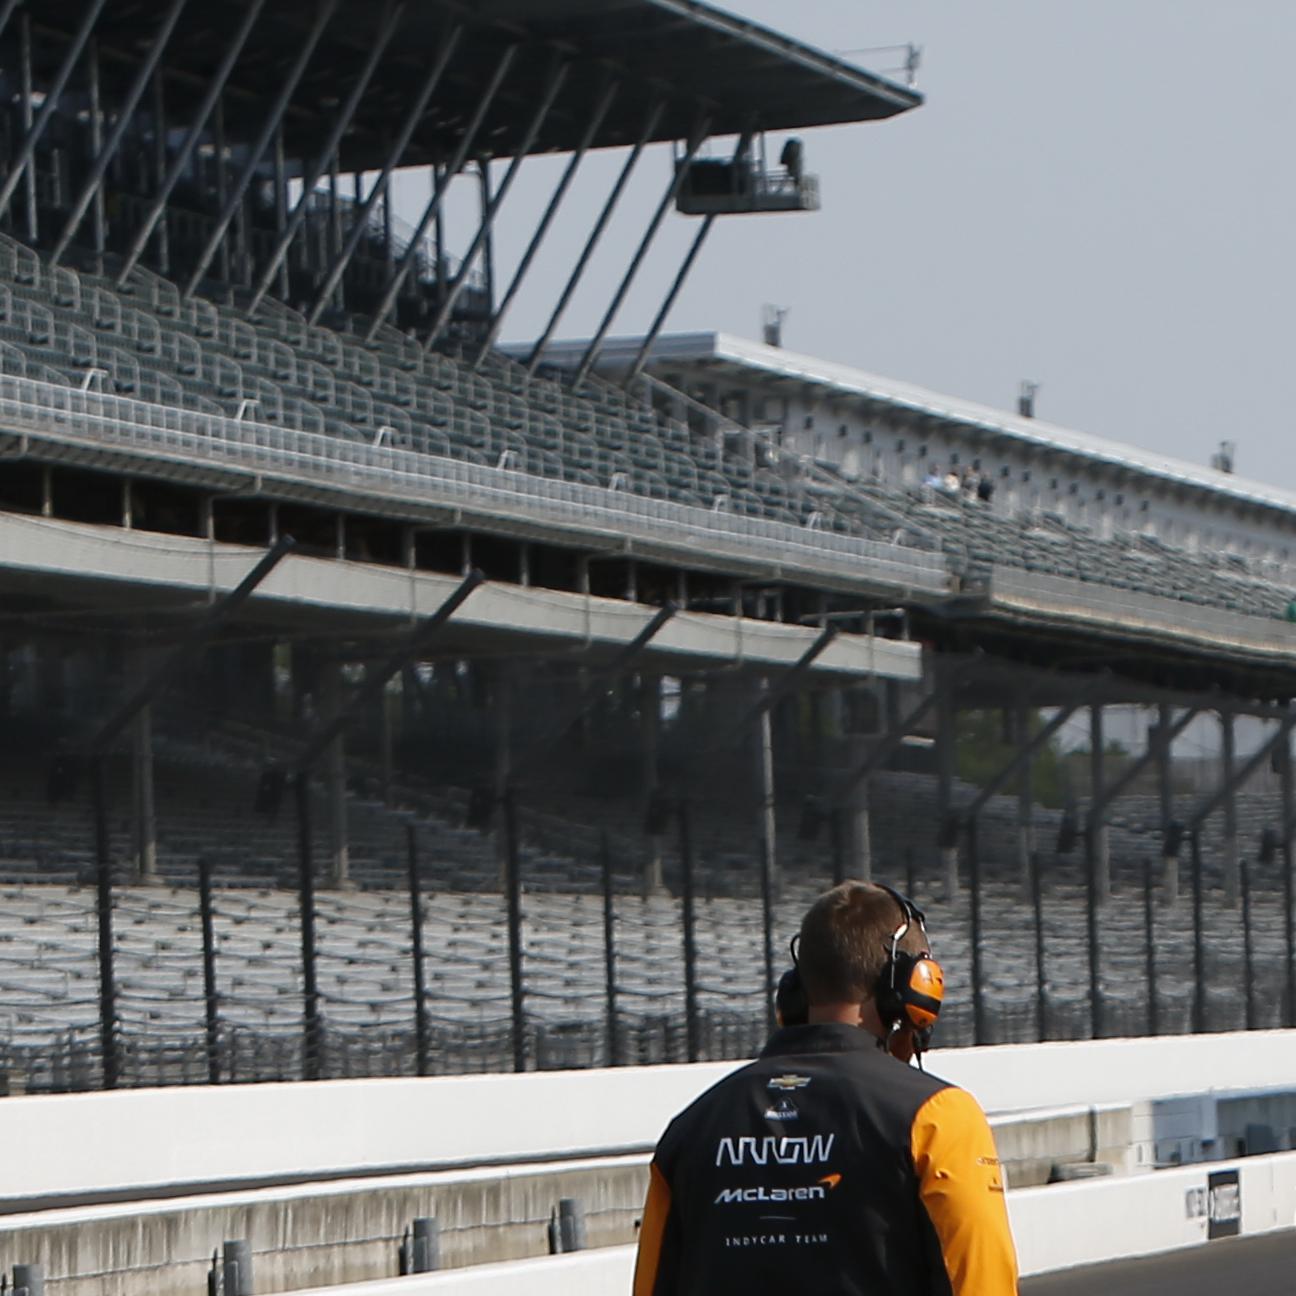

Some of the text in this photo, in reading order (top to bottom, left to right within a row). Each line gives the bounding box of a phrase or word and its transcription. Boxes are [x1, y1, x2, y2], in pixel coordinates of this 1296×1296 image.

[716, 1134, 835, 1166] ARROW
[714, 1186, 825, 1204] McLaren
[726, 1233, 829, 1247] INDYCAR TEAM
